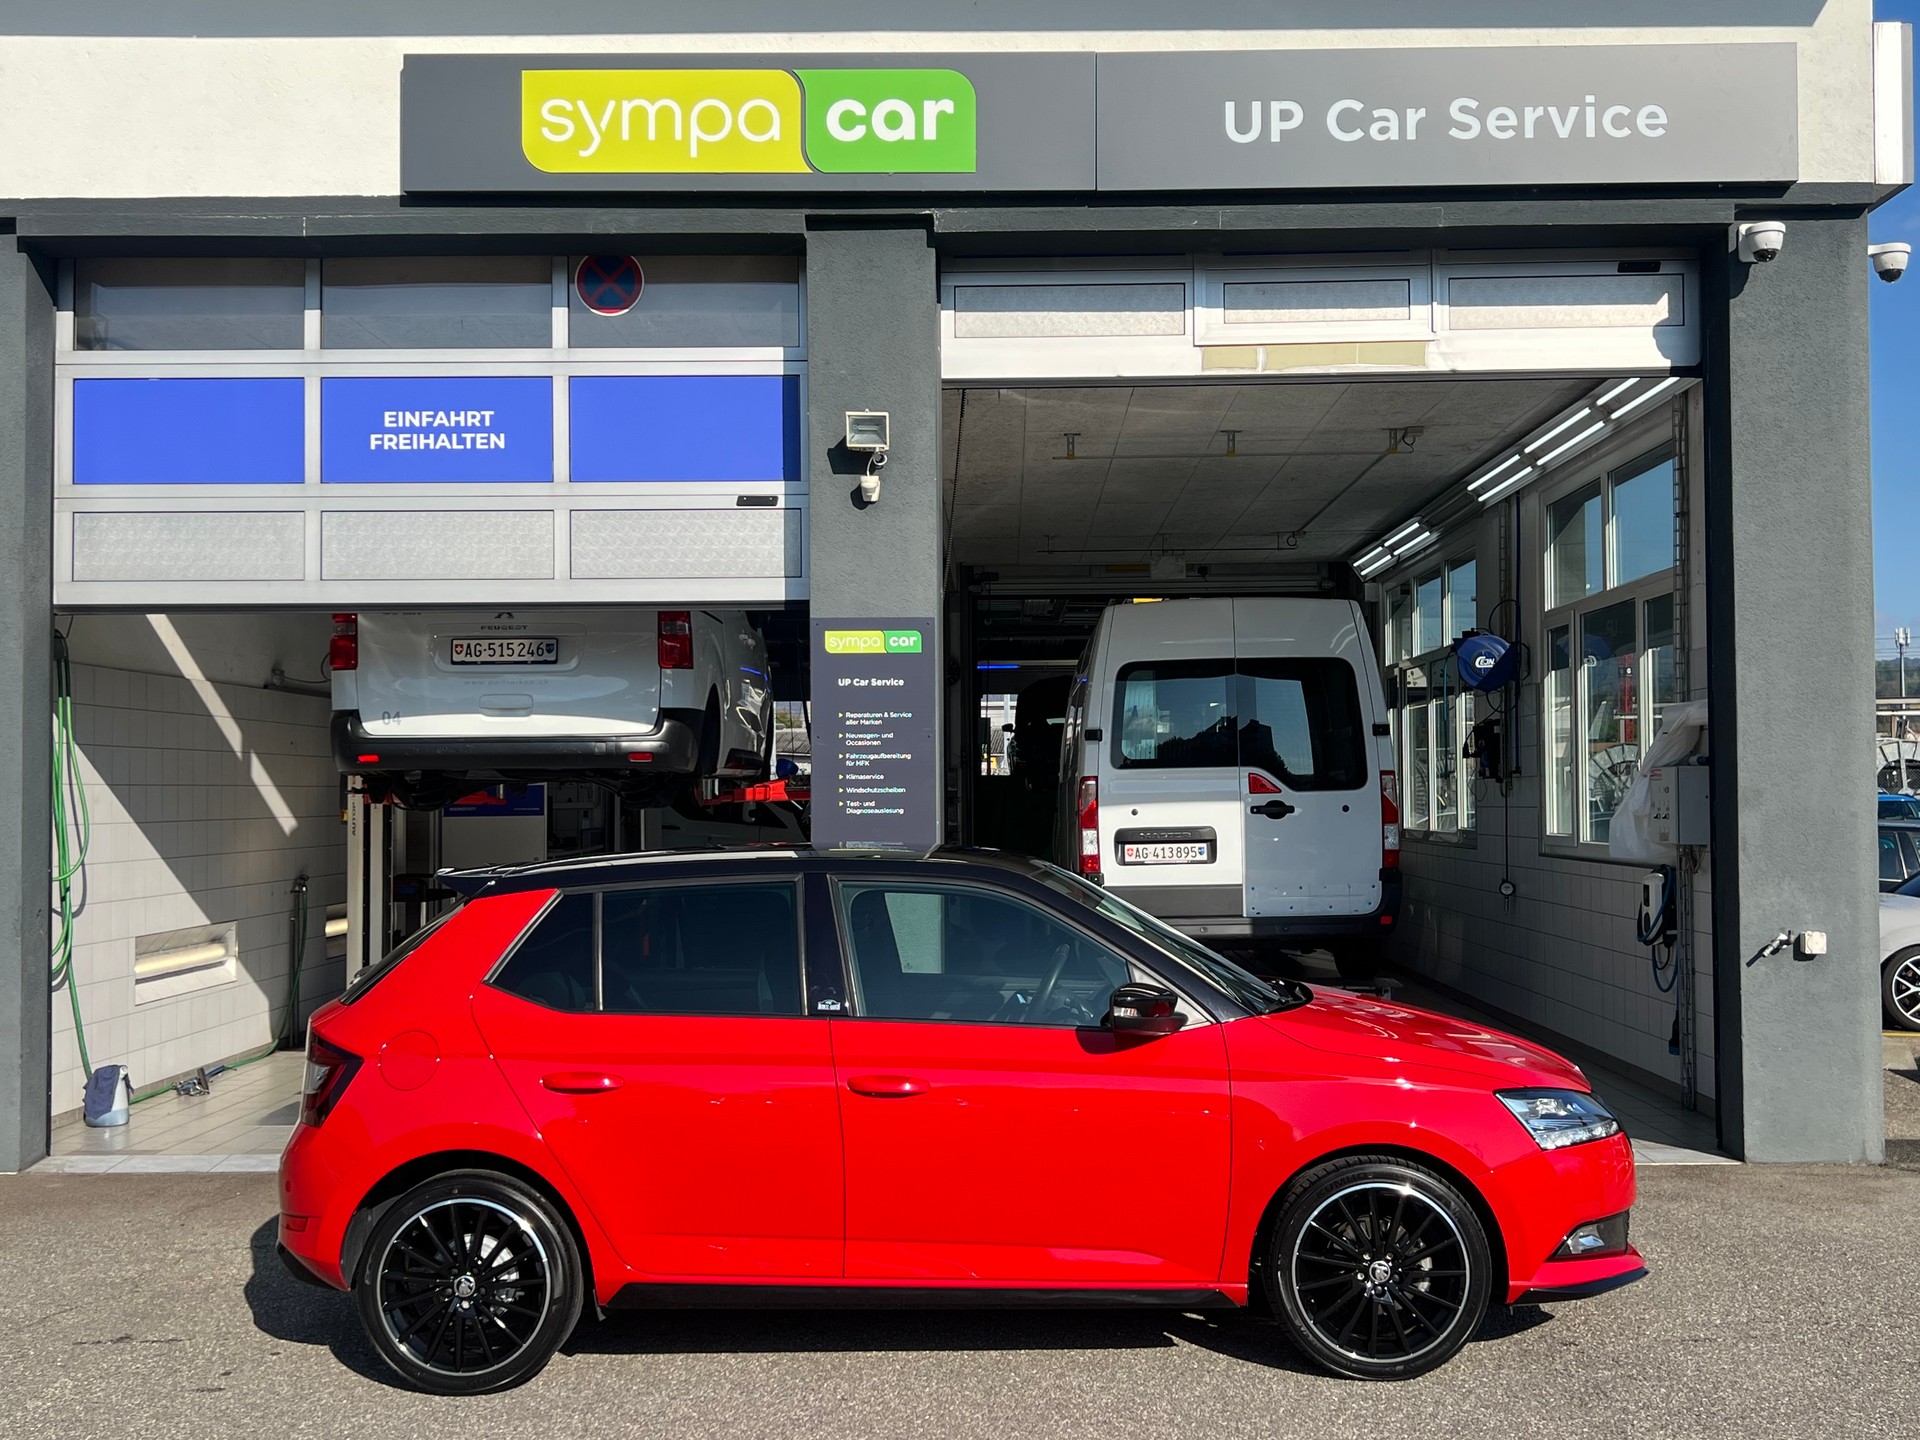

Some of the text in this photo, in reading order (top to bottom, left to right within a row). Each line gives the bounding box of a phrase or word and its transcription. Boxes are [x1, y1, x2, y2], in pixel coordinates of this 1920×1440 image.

[1225, 94, 1668, 144] UP Car Service
[540, 98, 955, 159] sympa car
[383, 410, 495, 428] EINFAHRT
[369, 432, 506, 450] FREIHALTEN
[829, 636, 918, 650] sympa car
[838, 678, 905, 687] UP Car Service
[381, 710, 402, 726] 04
[845, 712, 883, 720] Reparaturen
[845, 732, 880, 740] Neuwagen-
